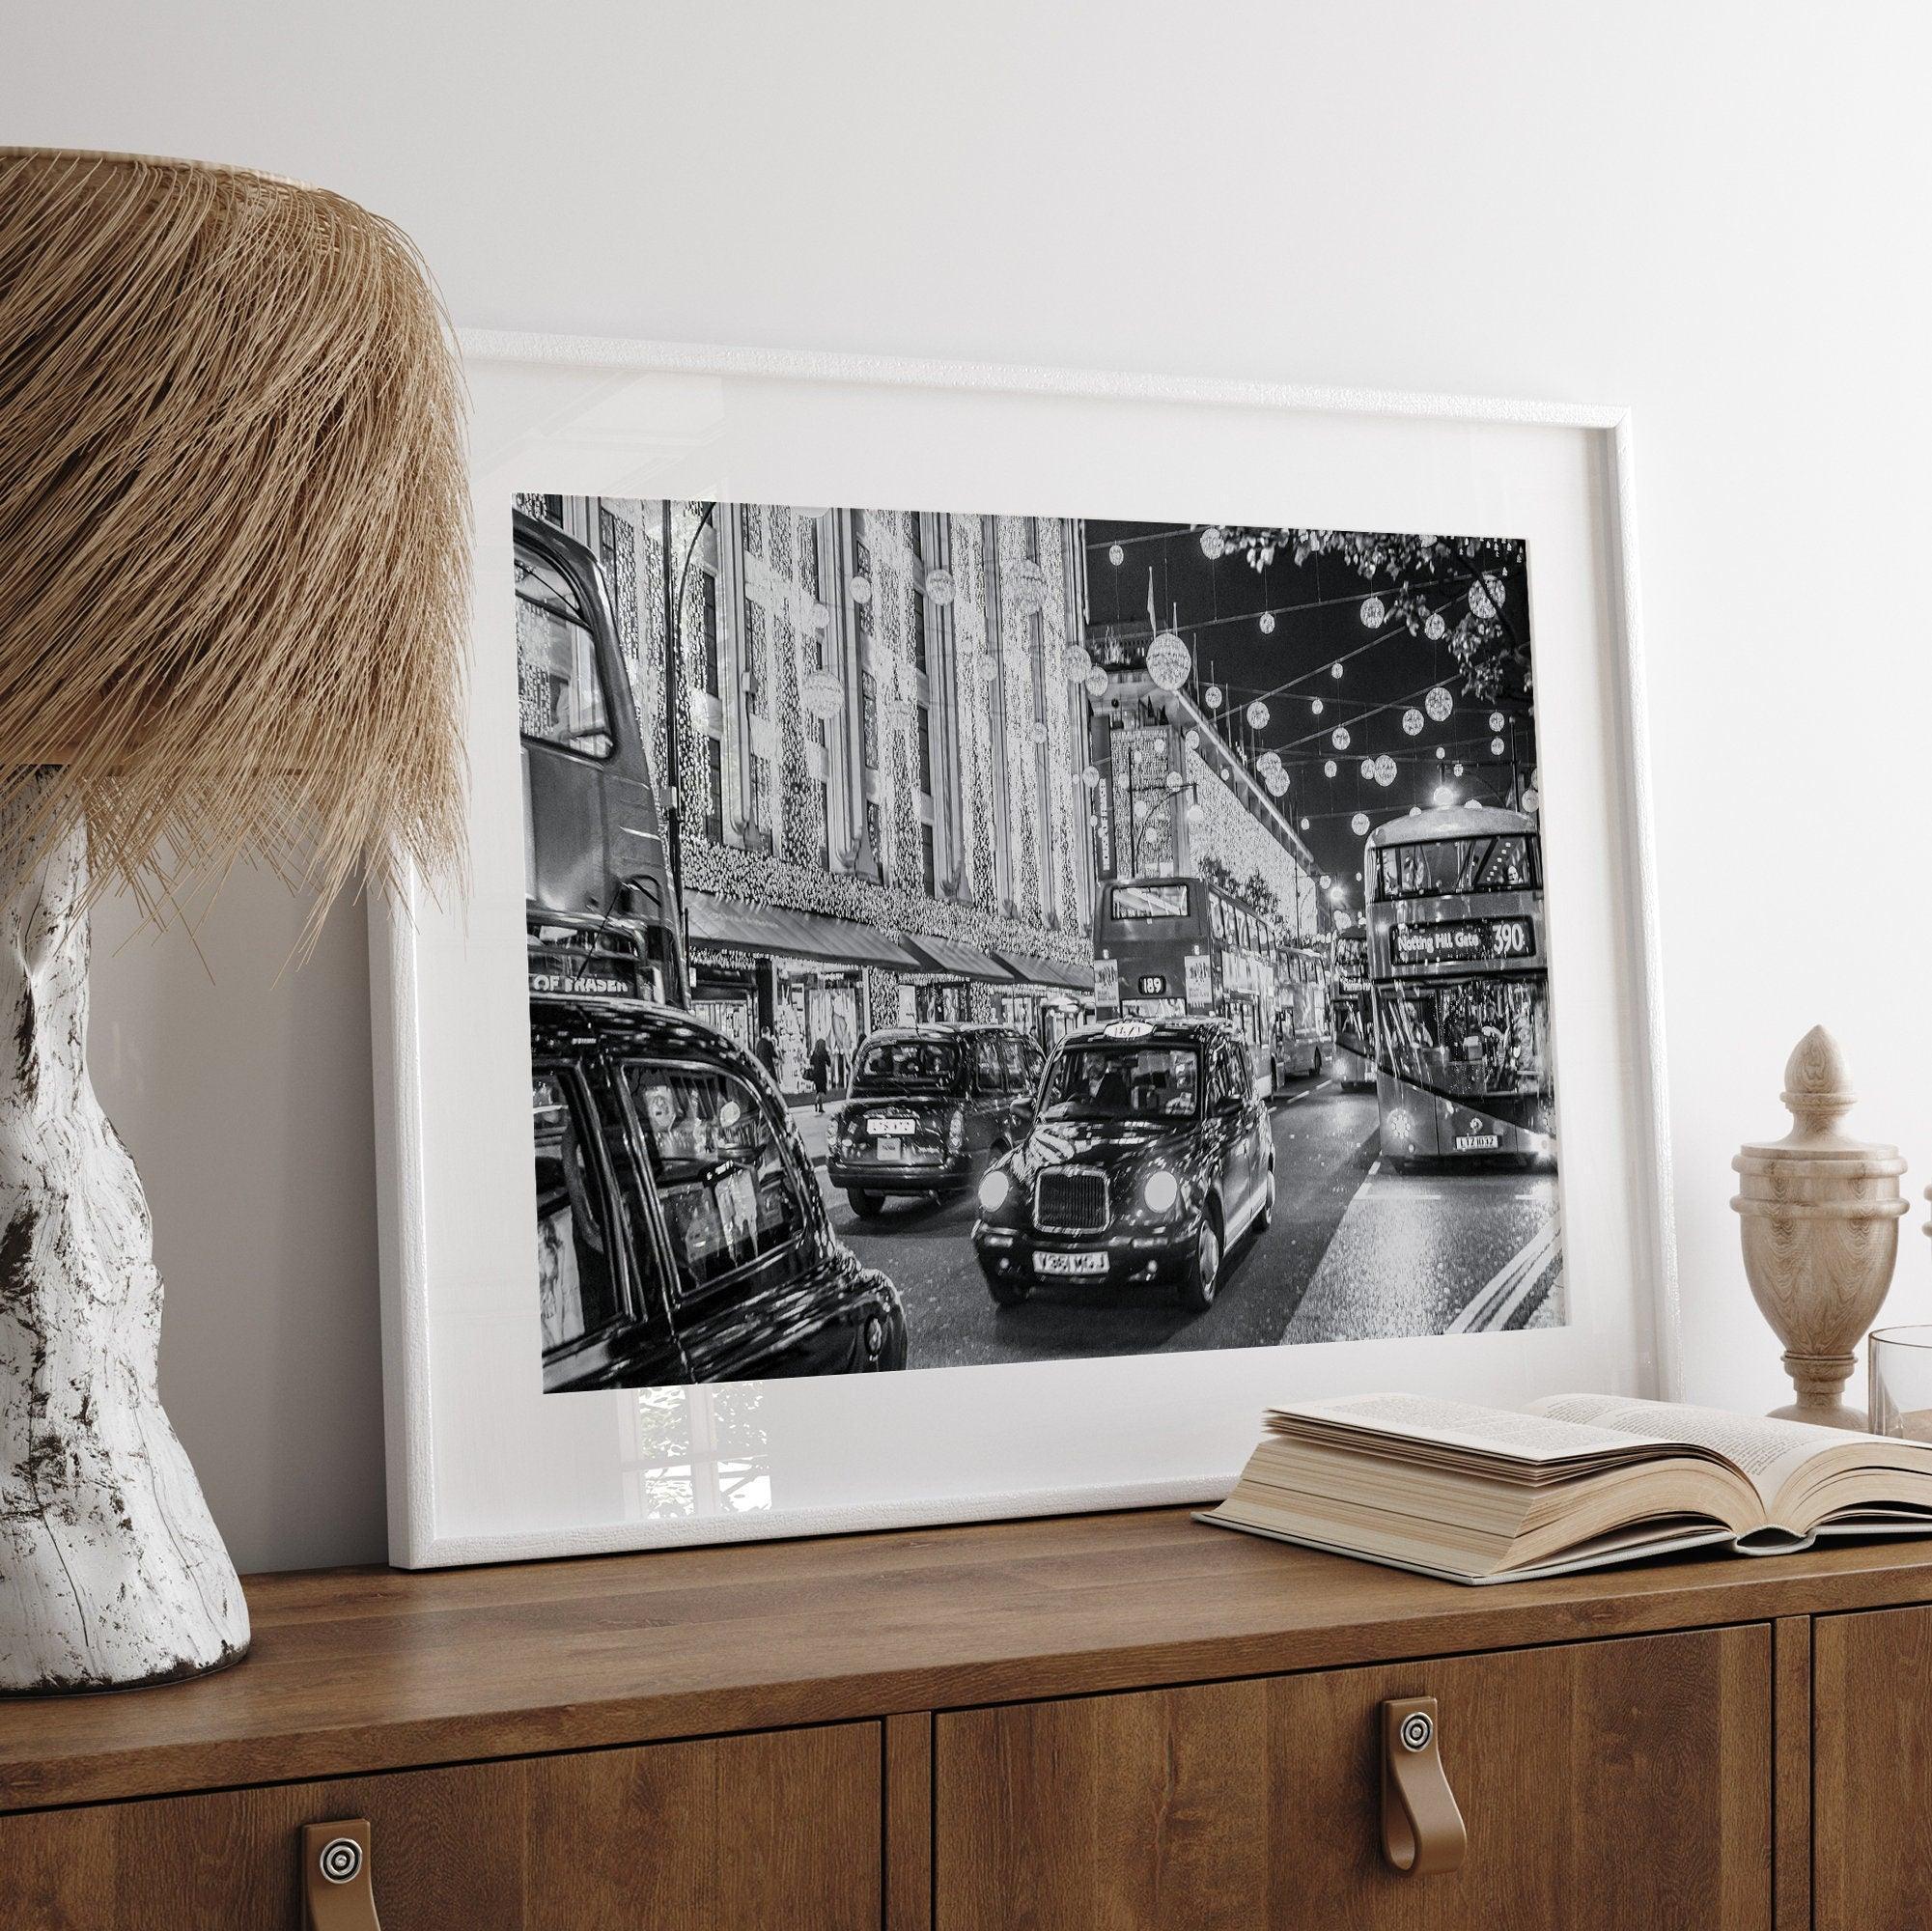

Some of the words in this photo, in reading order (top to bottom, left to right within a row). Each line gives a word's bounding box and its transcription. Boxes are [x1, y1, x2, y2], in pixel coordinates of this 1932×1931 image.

[1398, 936, 1434, 954] Notting
[1435, 933, 1453, 949] Hill
[1455, 932, 1480, 948] Gate
[1493, 923, 1525, 955] 390
[533, 975, 560, 992] OF
[1143, 977, 1162, 994] 189
